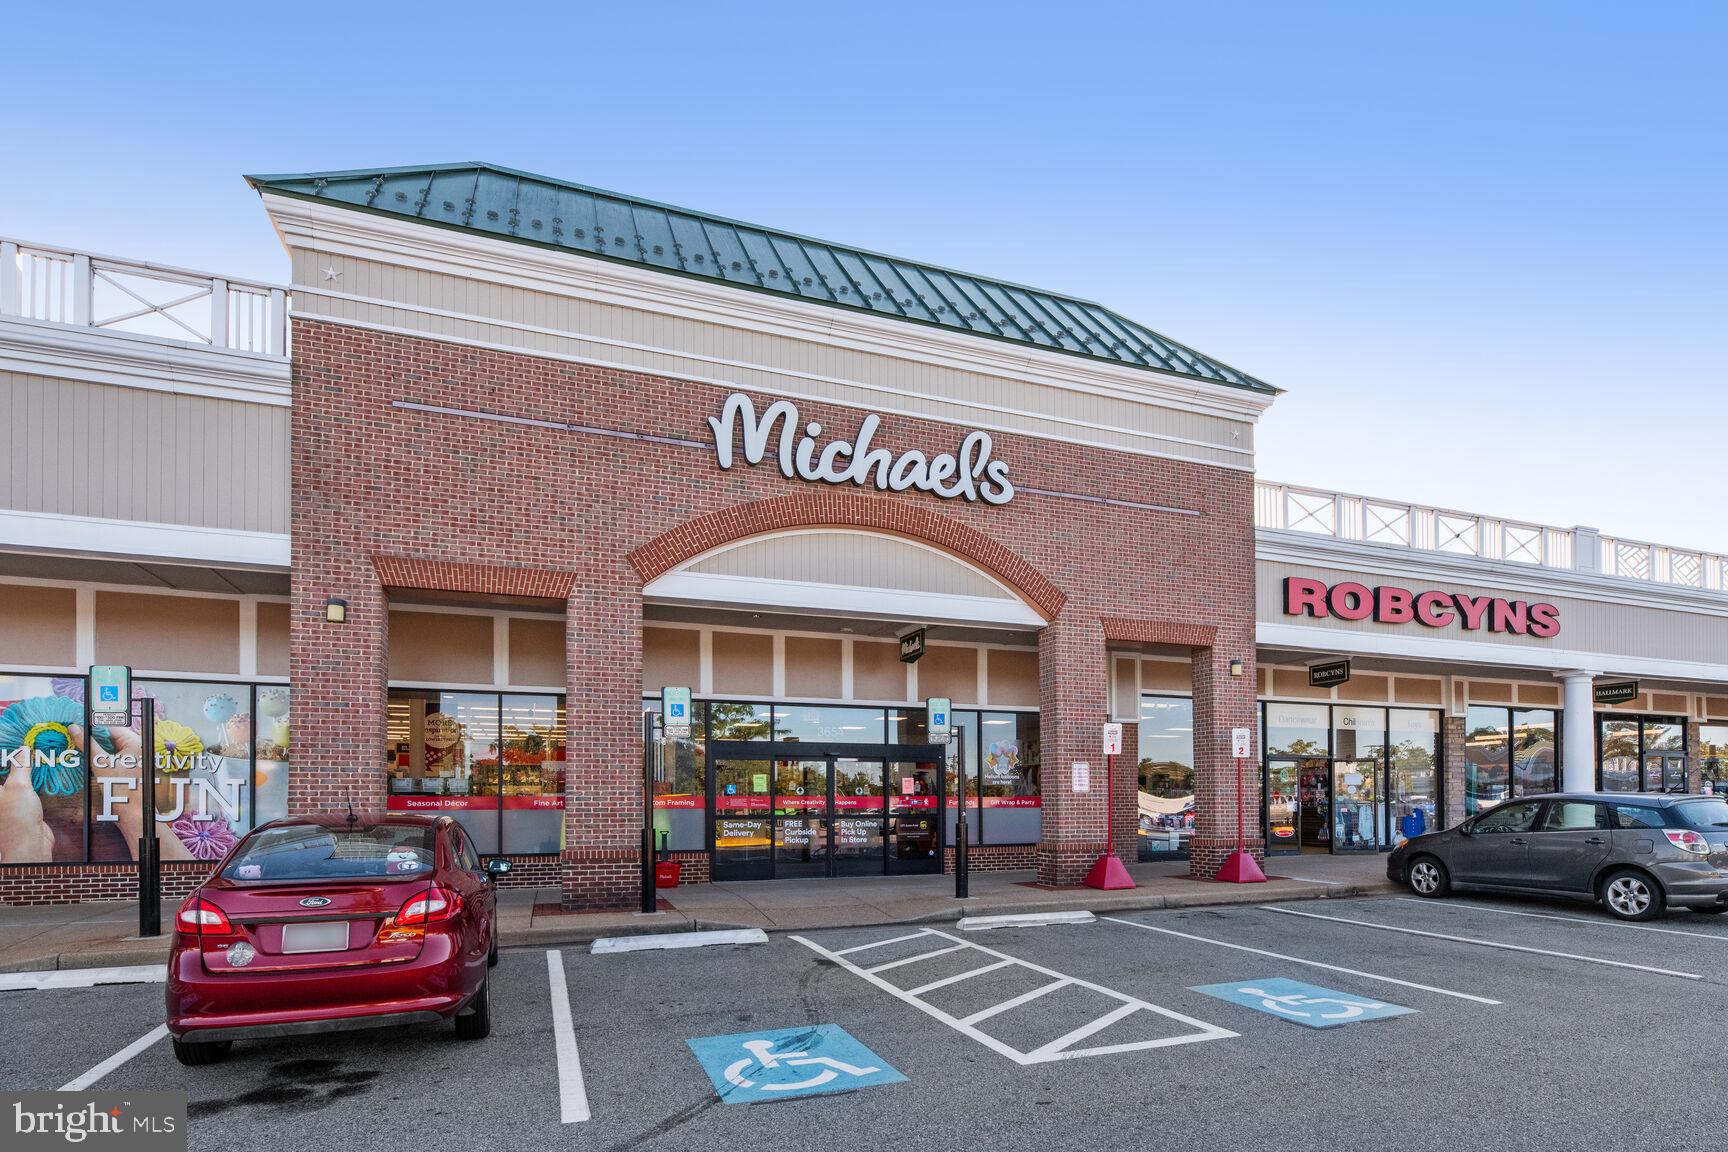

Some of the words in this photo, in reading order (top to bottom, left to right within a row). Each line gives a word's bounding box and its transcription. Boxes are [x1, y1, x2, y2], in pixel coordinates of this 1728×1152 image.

[707, 392, 1015, 505] Michaels
[1283, 577, 1561, 638] ROBCYNS
[1313, 668, 1344, 679] ROBCYNS
[1596, 687, 1632, 697] HALLMARK
[1110, 743, 1115, 752] 1
[1238, 746, 1245, 755] 2
[0, 749, 81, 768] KING
[96, 776, 247, 822] FUN
[444, 799, 469, 807] Décor
[667, 799, 695, 807] Framing
[723, 821, 762, 830] Same-Day
[841, 820, 855, 829] Buy
[855, 820, 878, 828] Online
[723, 829, 755, 838] Delivery
[784, 828, 817, 836] Curbside
[841, 828, 856, 836] Pick
[856, 828, 867, 837] Up
[784, 836, 809, 844] Pickup
